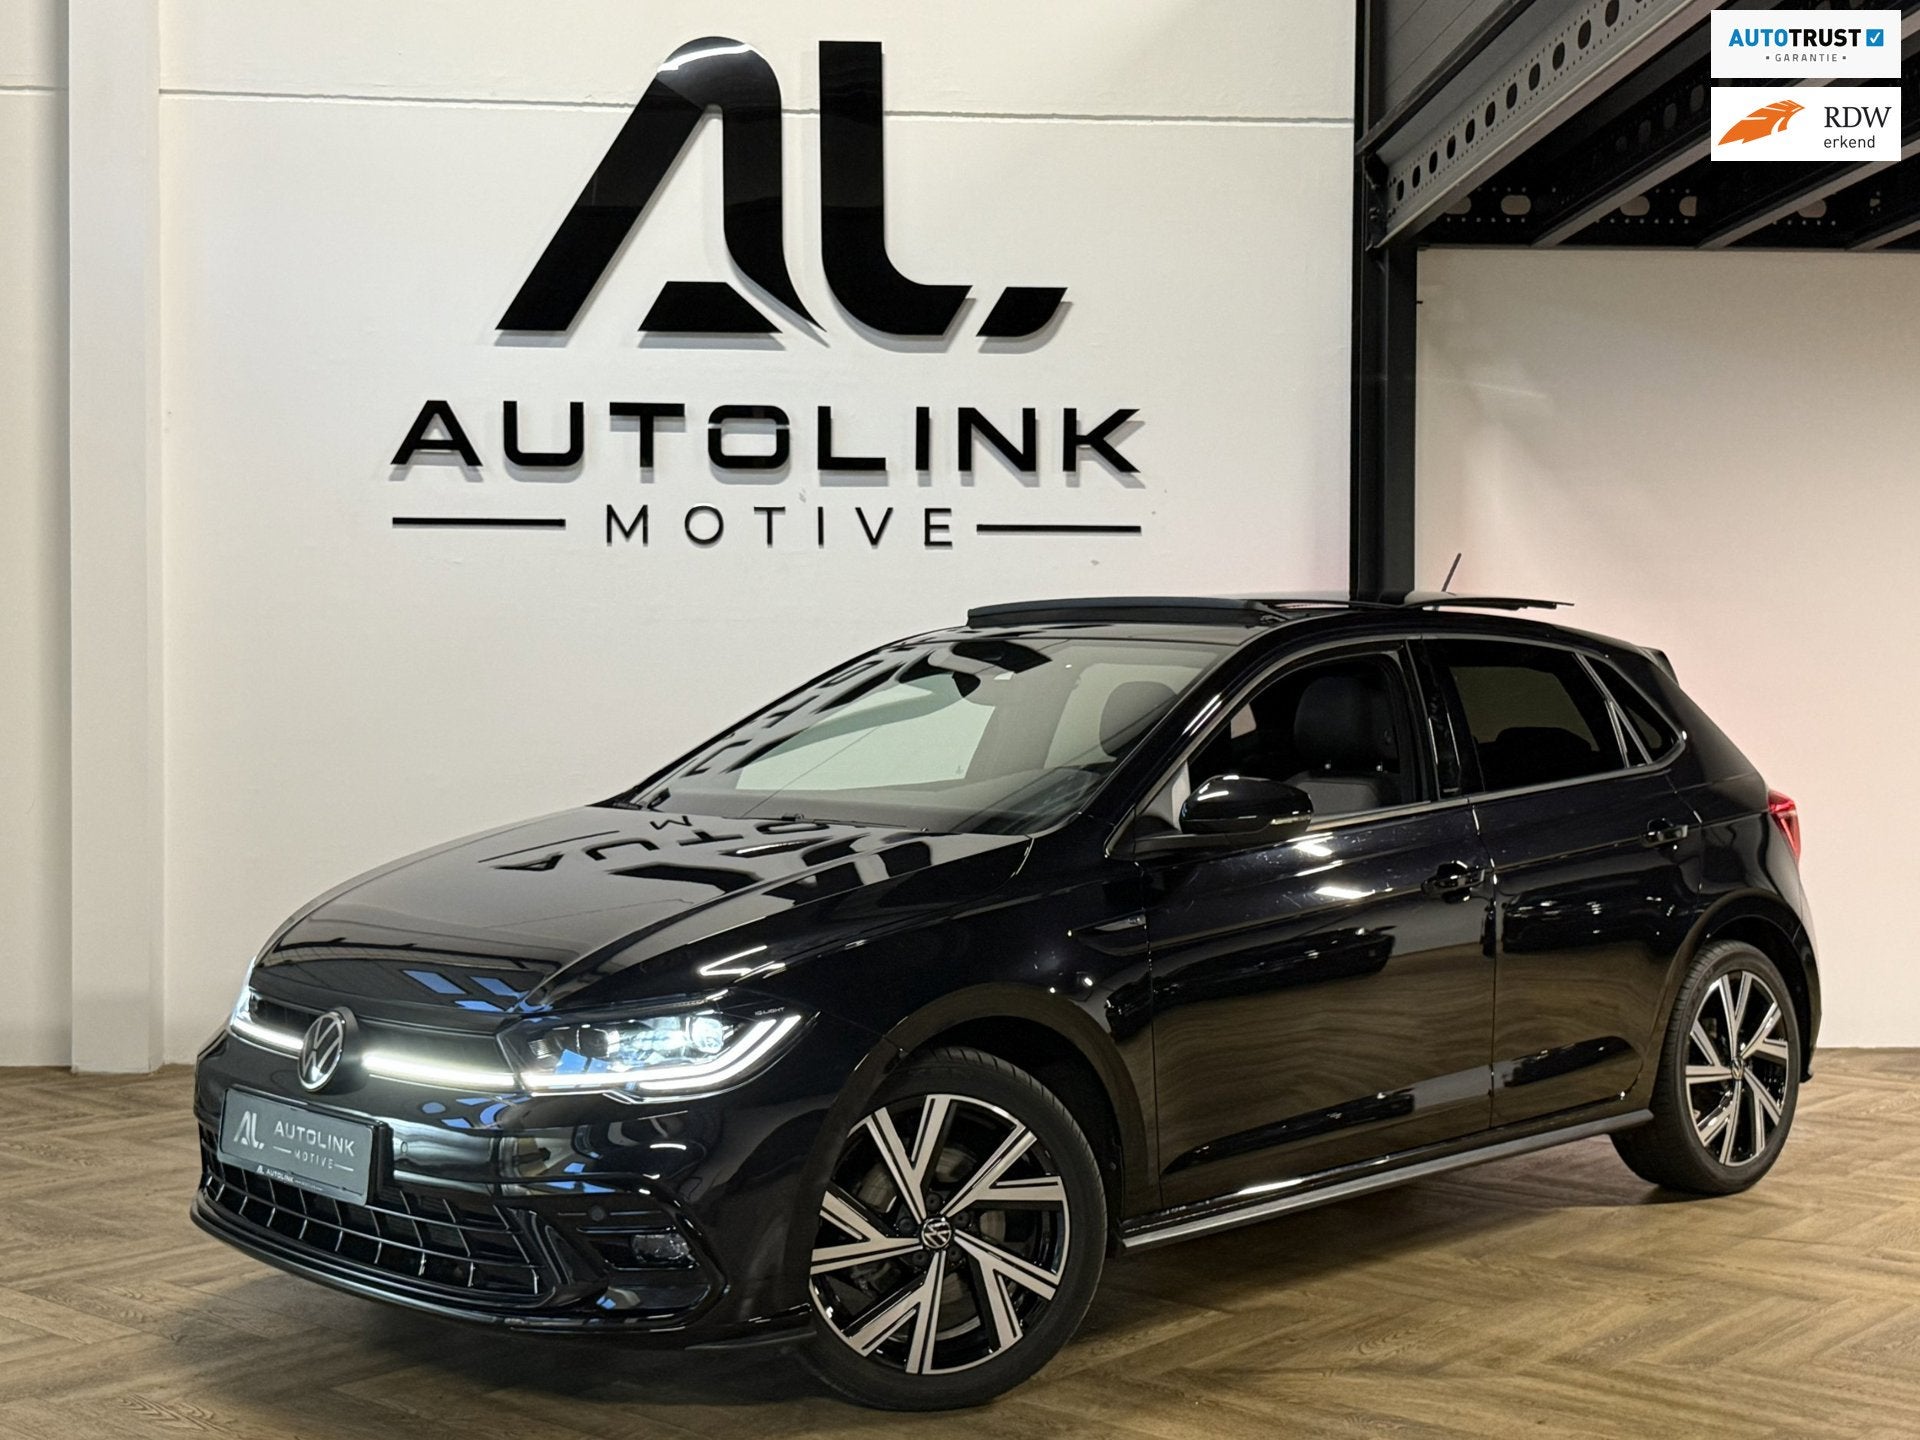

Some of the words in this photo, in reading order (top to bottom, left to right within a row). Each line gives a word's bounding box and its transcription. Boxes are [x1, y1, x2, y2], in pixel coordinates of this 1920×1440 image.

[390, 399, 1141, 474] AUTOLINK
[606, 503, 953, 547] MOTIVE
[273, 1120, 355, 1157] AUTOLINK
[294, 1150, 334, 1169] MOTIVE
